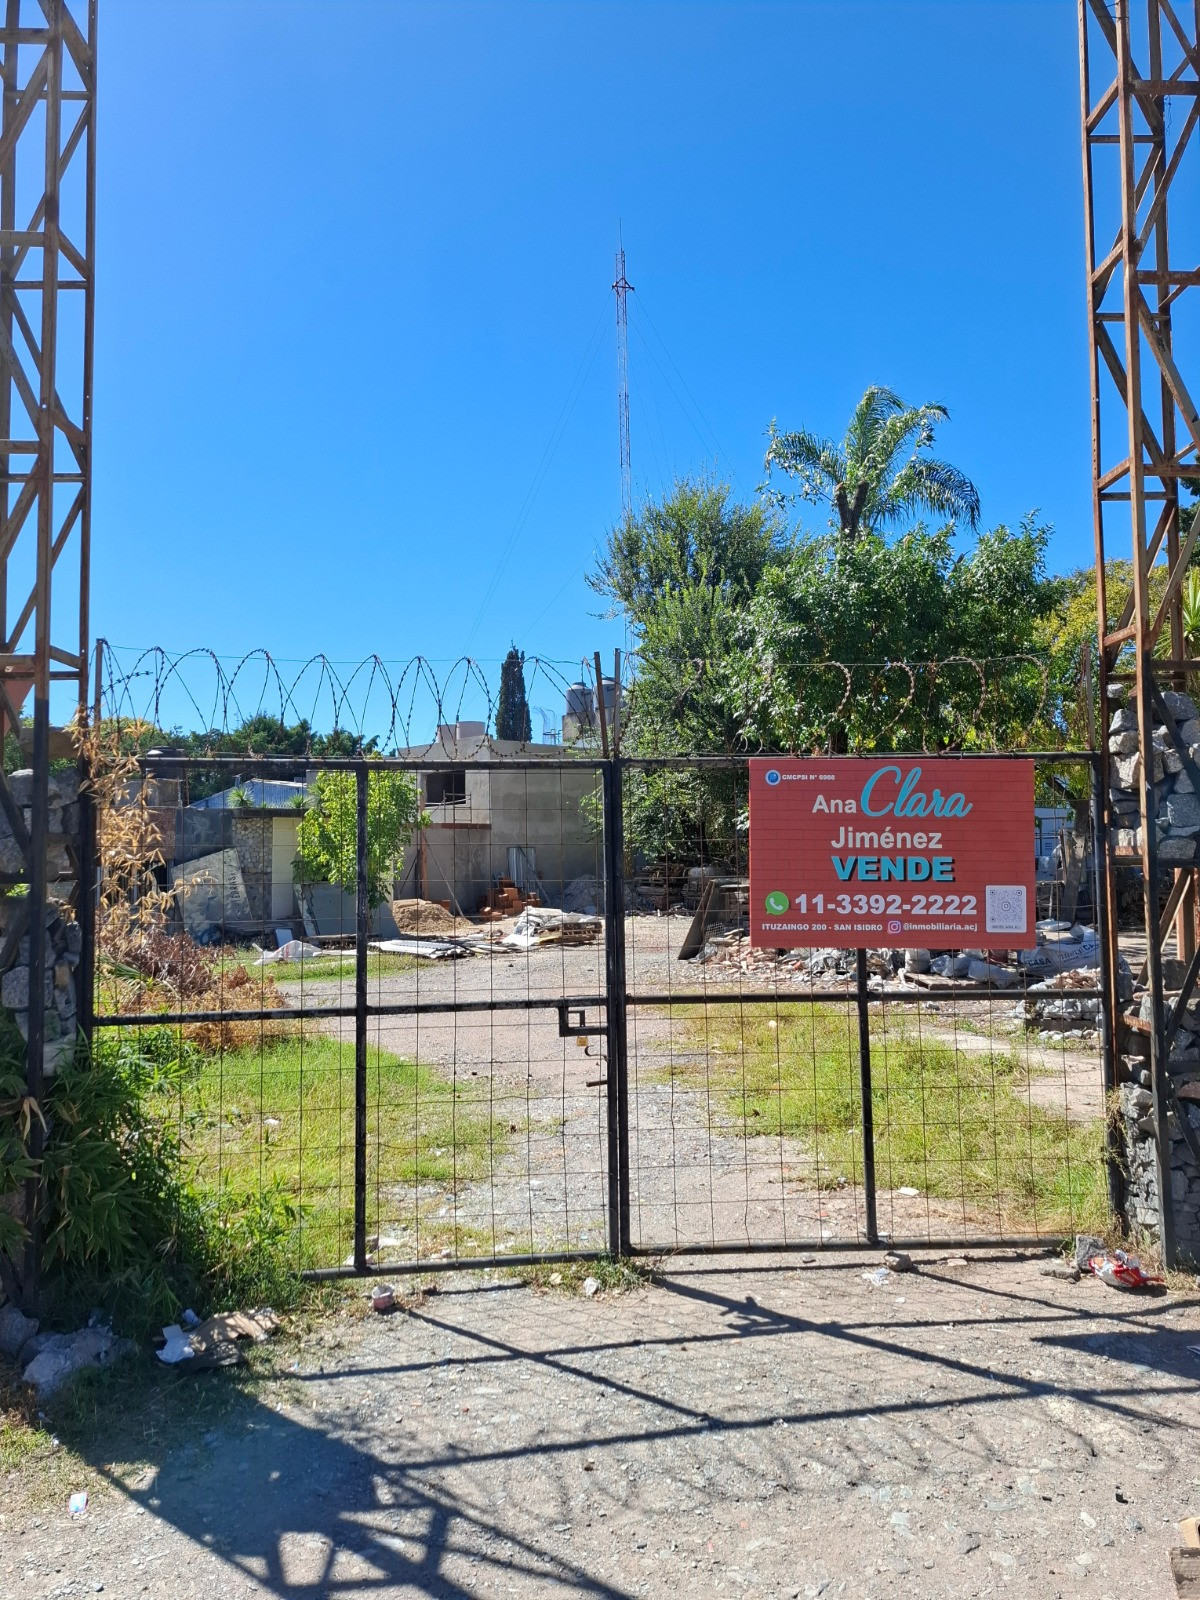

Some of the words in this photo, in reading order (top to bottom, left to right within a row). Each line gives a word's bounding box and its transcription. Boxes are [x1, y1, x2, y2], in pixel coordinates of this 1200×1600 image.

[812, 795, 857, 813] Ana
[860, 765, 973, 817] Clara
[831, 826, 943, 849] Jiménez
[831, 856, 956, 882] VENDE
[795, 893, 978, 915] 11-3392-2222
[762, 923, 810, 931] ITUZAINGO
[811, 923, 827, 931] 200
[903, 922, 978, 932] @inmobiliaria.acj
